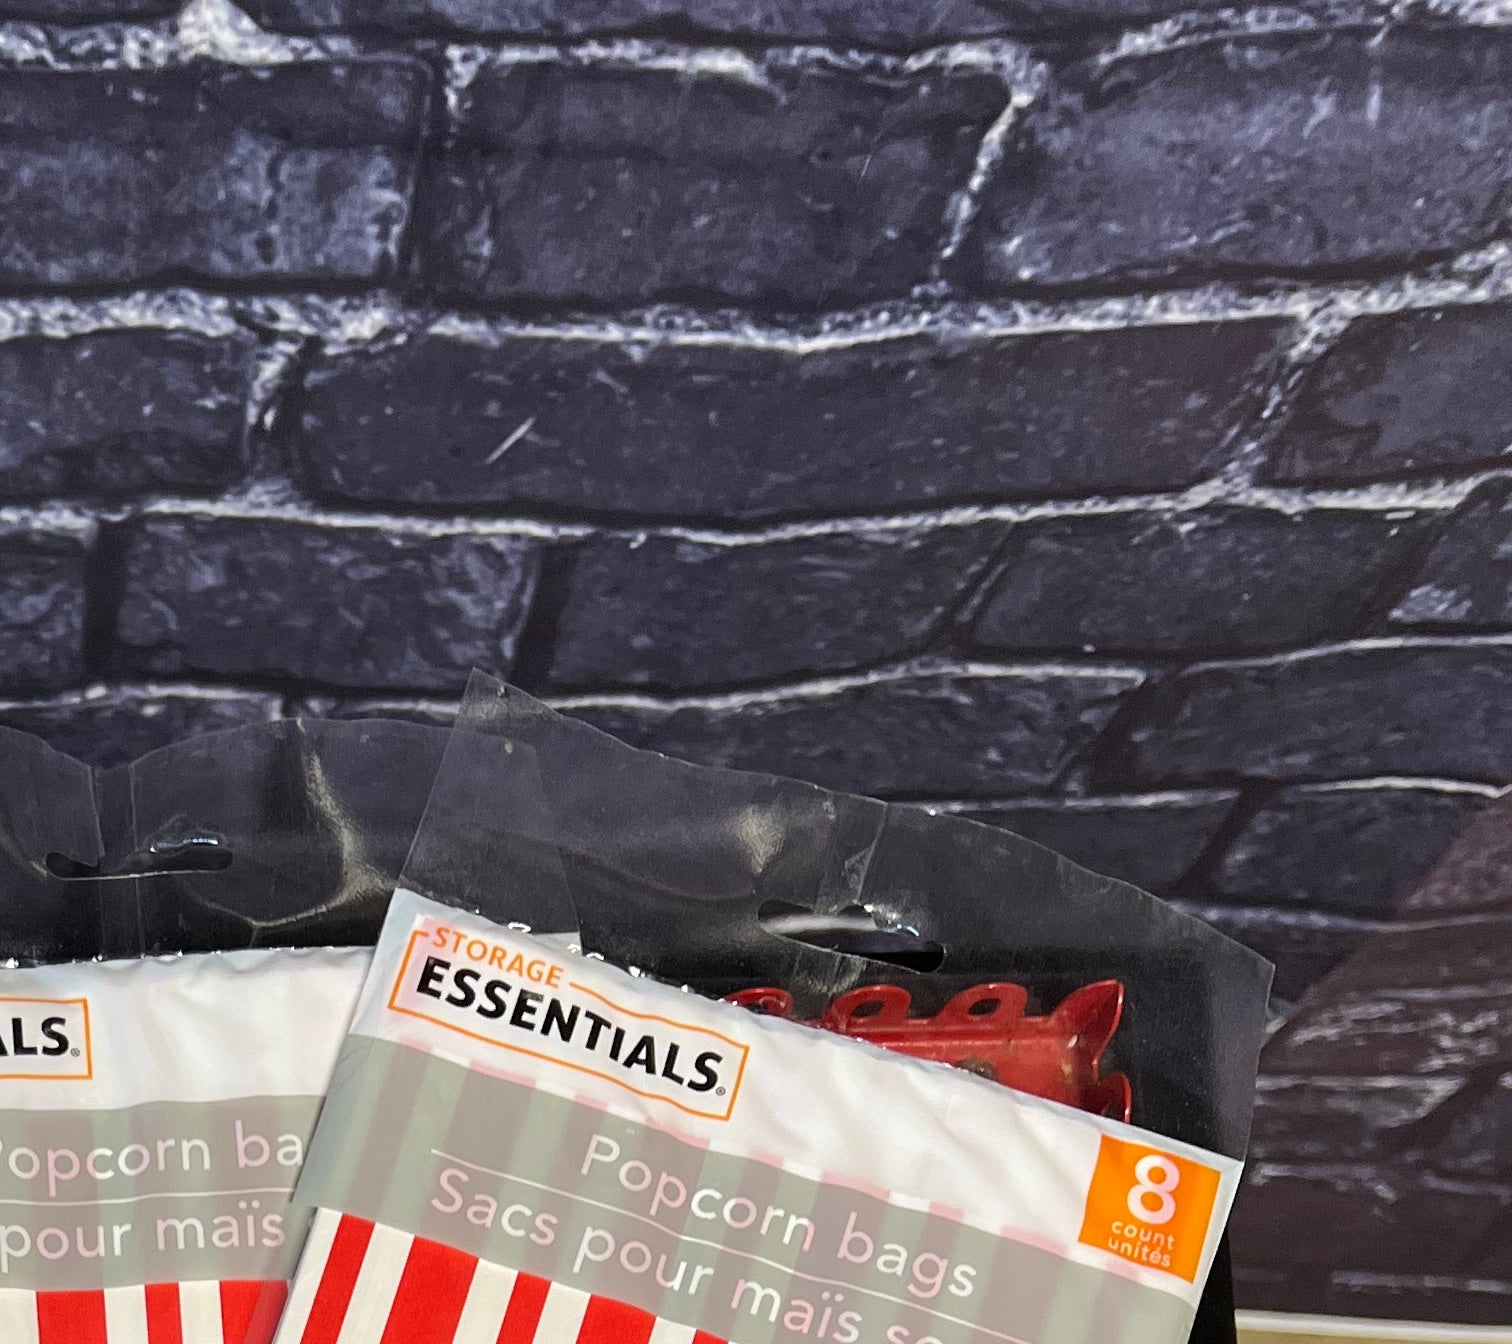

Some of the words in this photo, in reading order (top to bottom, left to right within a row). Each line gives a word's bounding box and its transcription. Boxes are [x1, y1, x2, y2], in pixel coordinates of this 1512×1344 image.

[434, 925, 565, 989] STORAGE
[235, 1120, 303, 1168] ba
[581, 1135, 813, 1251] Popcorn
[839, 1210, 977, 1302] bags
[1127, 1154, 1180, 1224] 8
[0, 1217, 132, 1272] pour
[156, 1201, 285, 1250] maïs
[431, 1167, 555, 1246] Sacs
[573, 1222, 714, 1302] pour
[732, 1269, 862, 1344] maïs
[1108, 1238, 1171, 1267] unités
[1112, 1221, 1175, 1249] count
